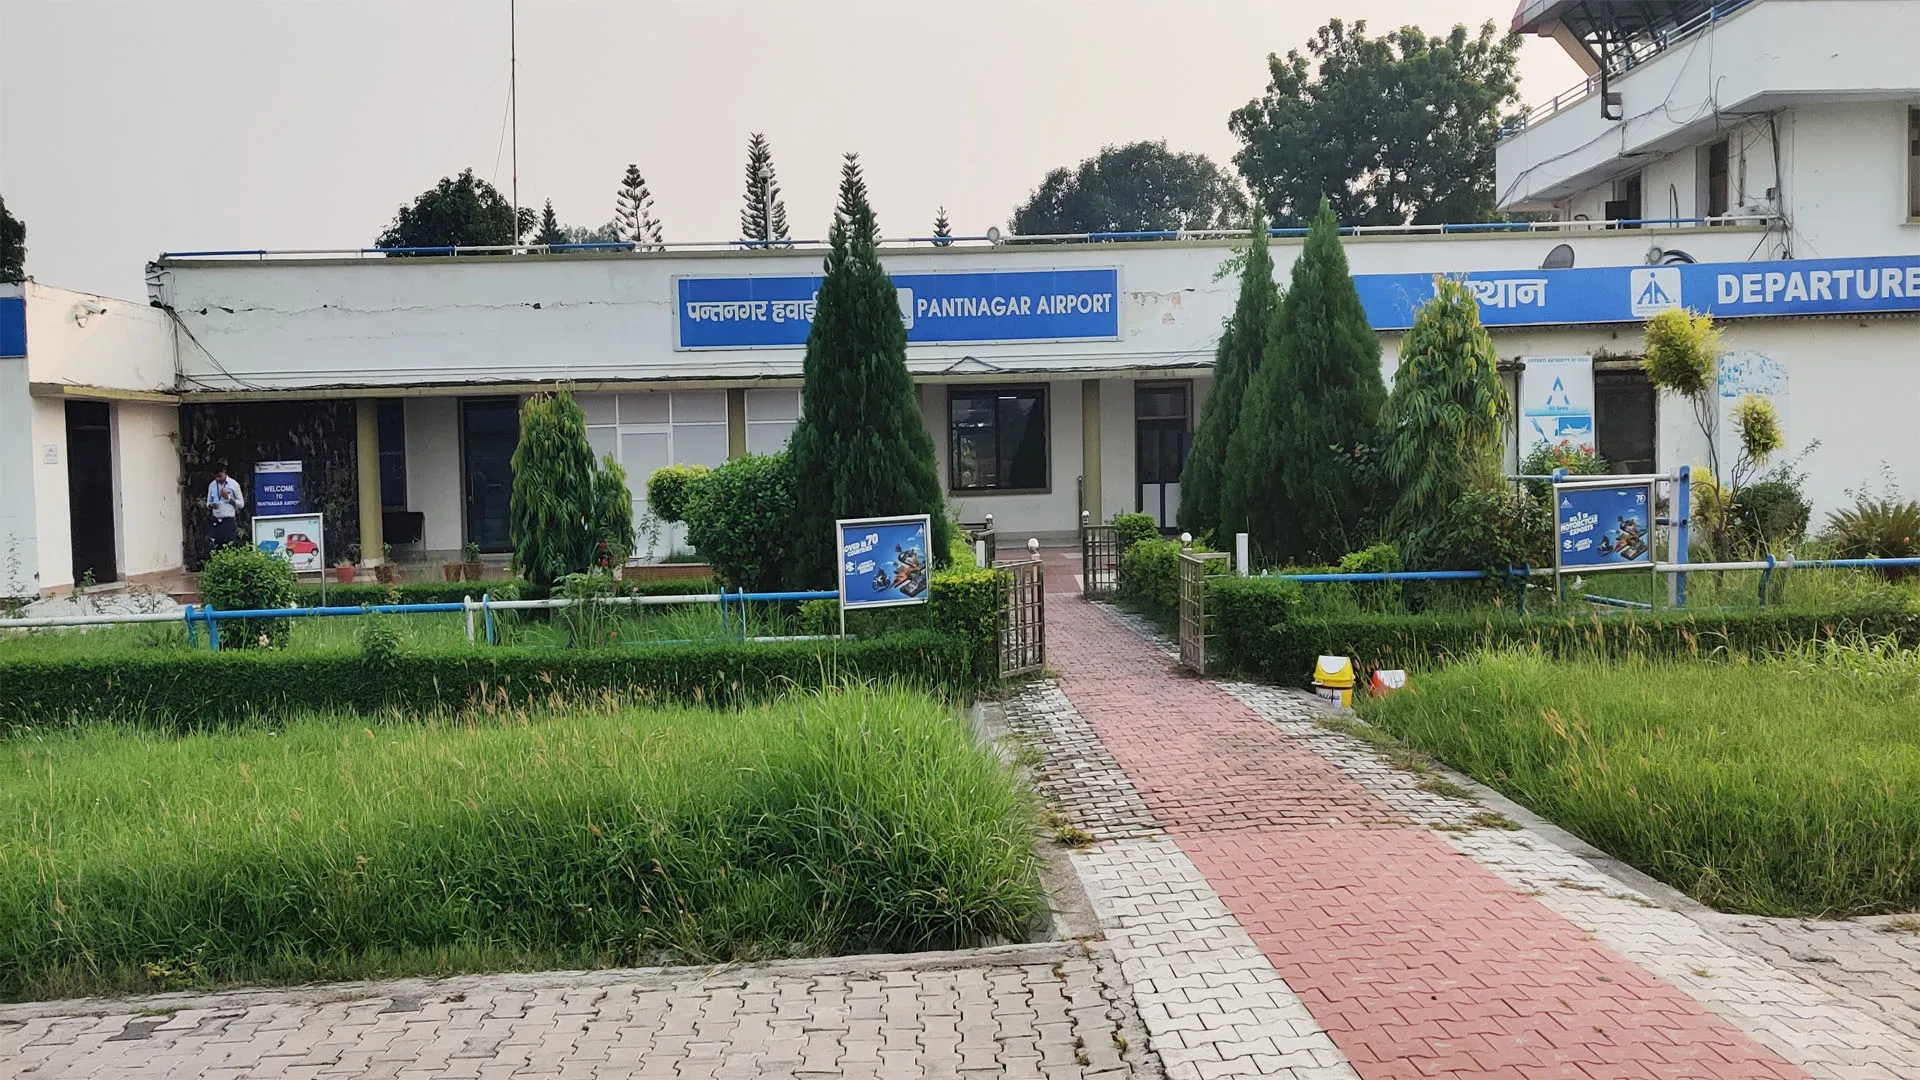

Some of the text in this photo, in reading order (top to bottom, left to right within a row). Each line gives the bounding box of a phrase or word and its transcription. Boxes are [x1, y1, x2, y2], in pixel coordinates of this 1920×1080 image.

[1717, 268, 1920, 304] DEPARTURE
[686, 300, 768, 322] पन्तनगर
[917, 293, 1113, 318] PANTNAGAR AIRPORT
[866, 534, 878, 545] 70
